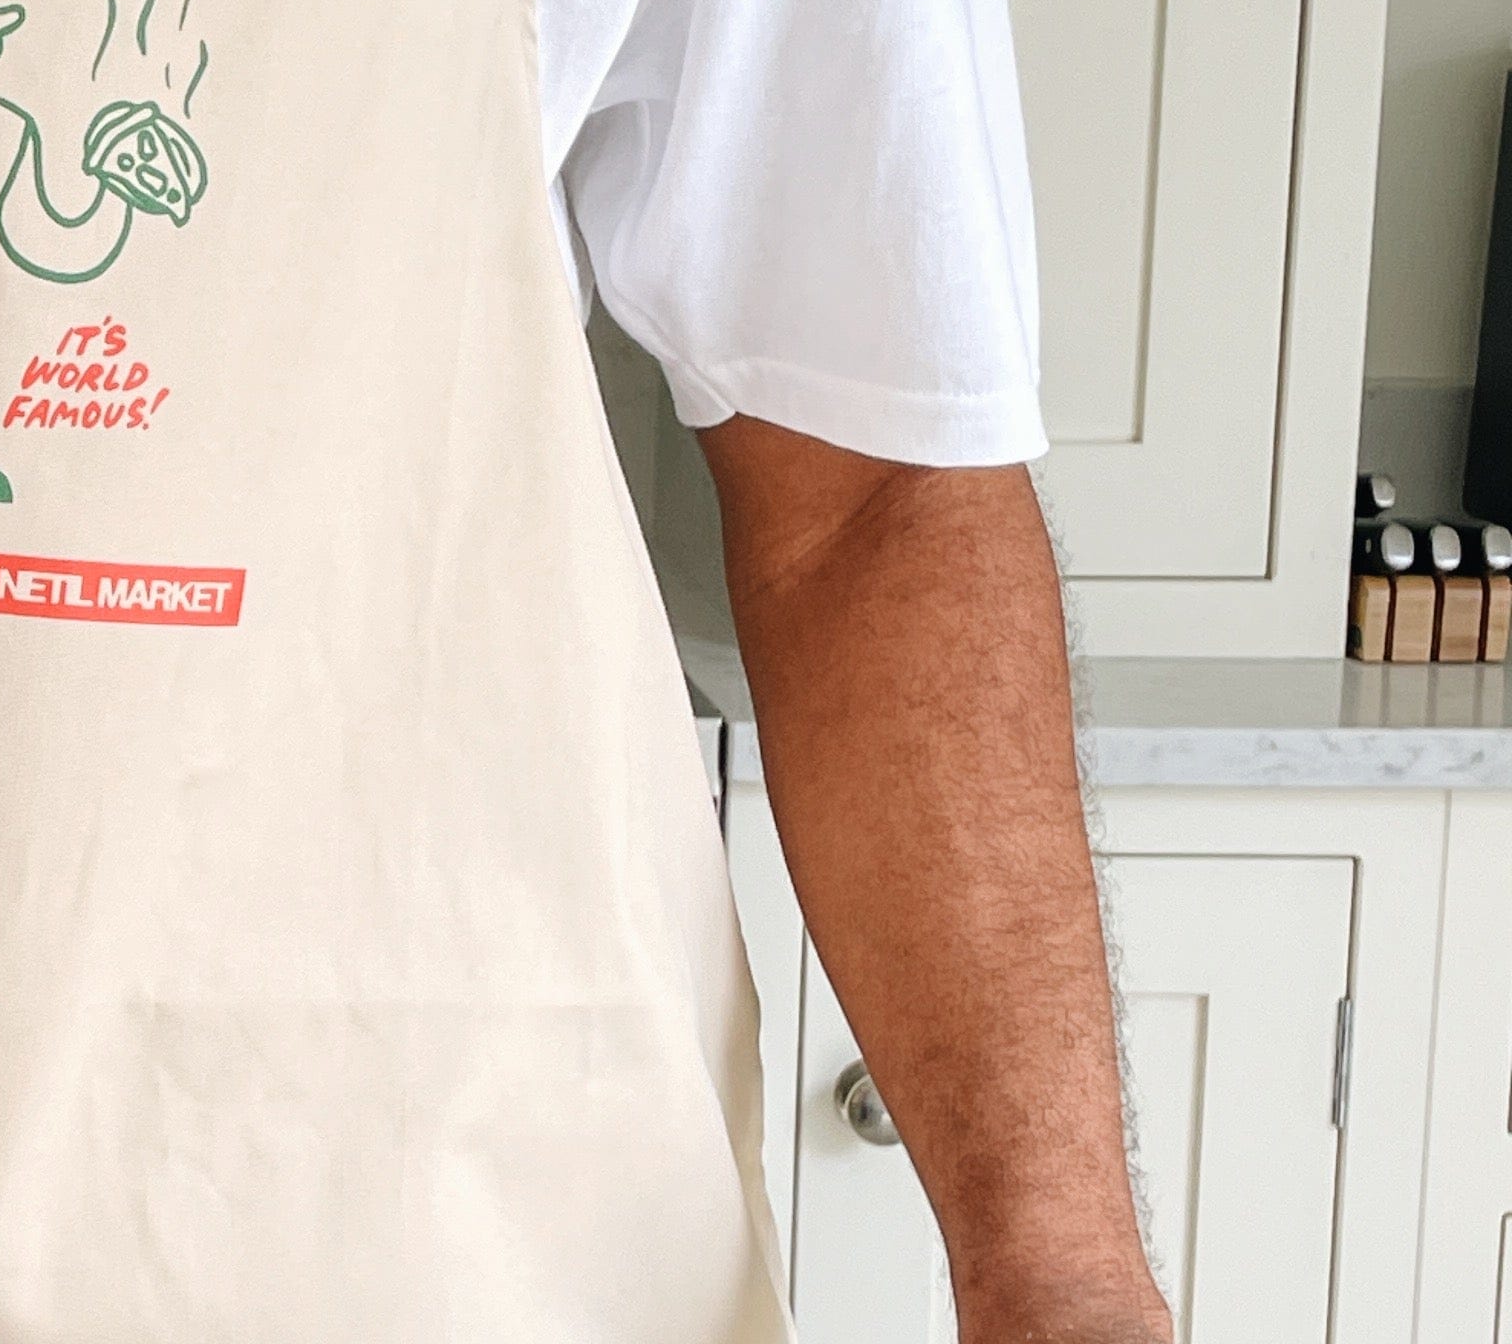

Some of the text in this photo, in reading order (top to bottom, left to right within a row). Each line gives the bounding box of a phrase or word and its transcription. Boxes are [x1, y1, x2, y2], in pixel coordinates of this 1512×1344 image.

[57, 316, 128, 357] IT'S
[20, 357, 149, 392] WORLD
[3, 388, 170, 429] FAMOUS!
[97, 576, 233, 614] MARKET
